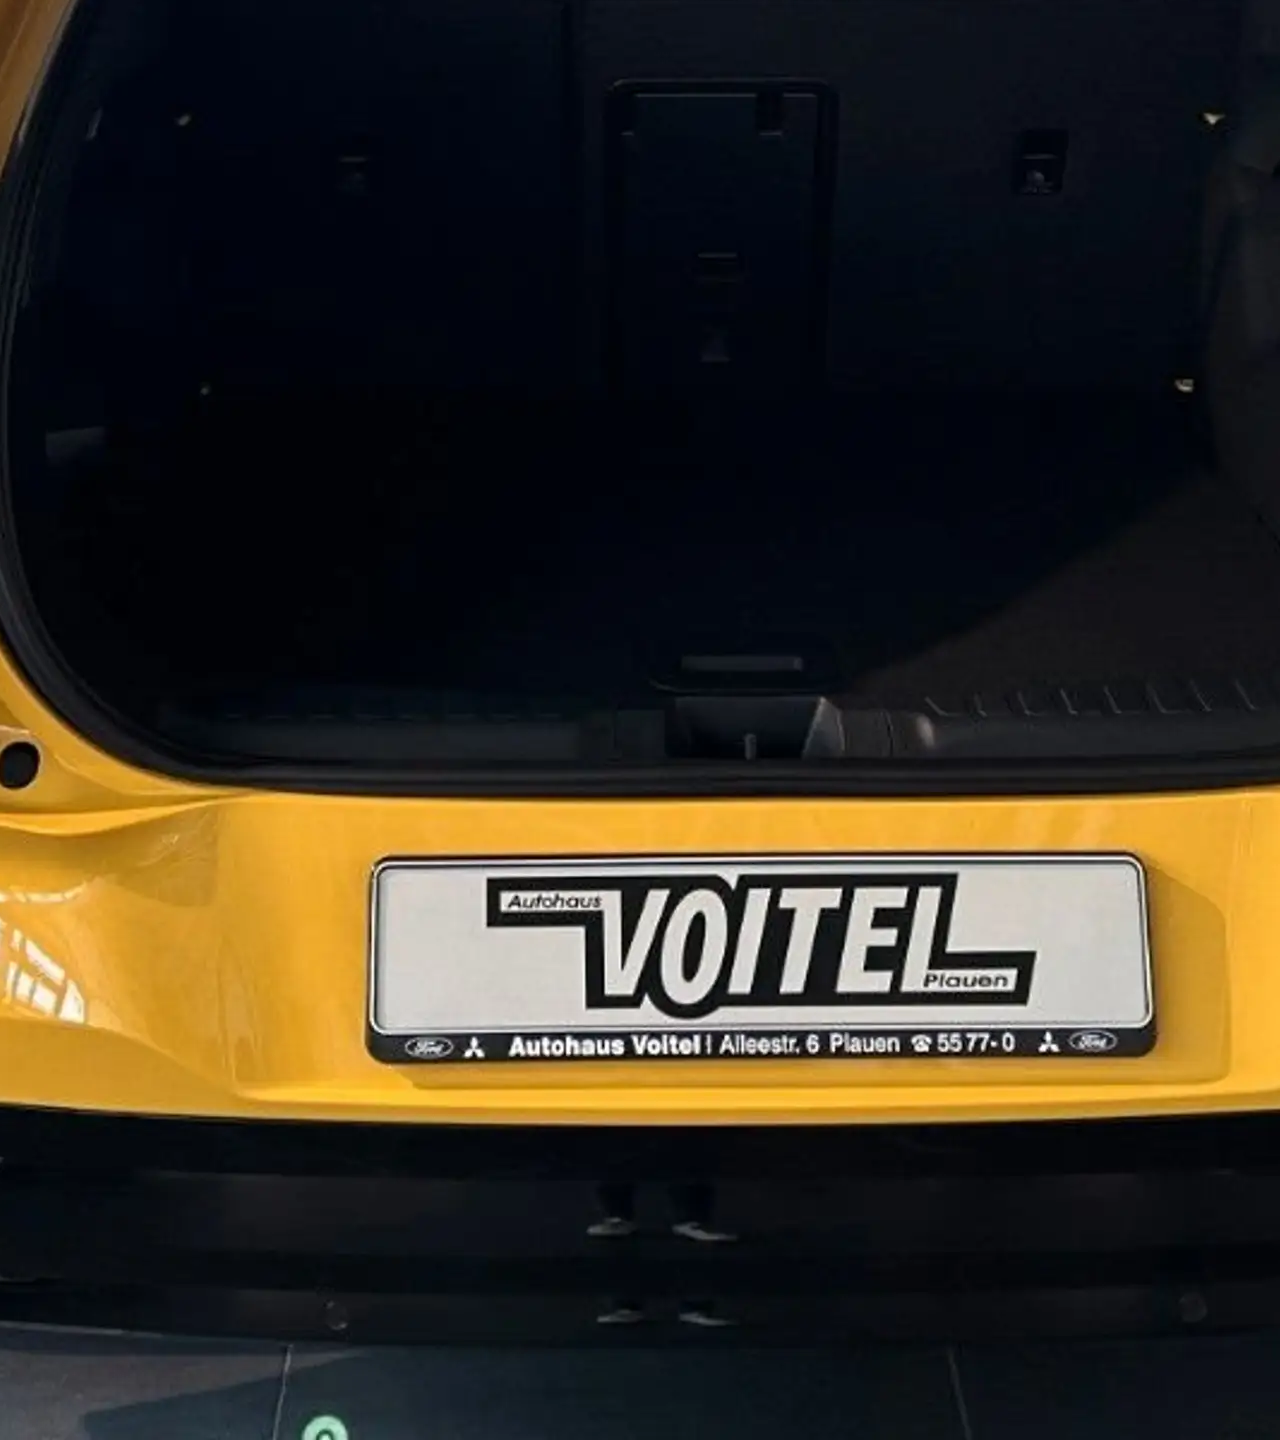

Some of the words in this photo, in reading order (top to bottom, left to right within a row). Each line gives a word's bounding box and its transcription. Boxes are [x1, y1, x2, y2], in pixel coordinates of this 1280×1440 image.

[507, 893, 603, 910] Autohaus
[602, 884, 1018, 1006] VOITEL
[923, 973, 1009, 988] Plauen
[508, 1036, 625, 1058] Autohaus
[631, 1034, 701, 1056] Voitel
[720, 1034, 800, 1055] Alleestr.
[805, 1034, 820, 1054] 6
[829, 1032, 900, 1053] Plauen
